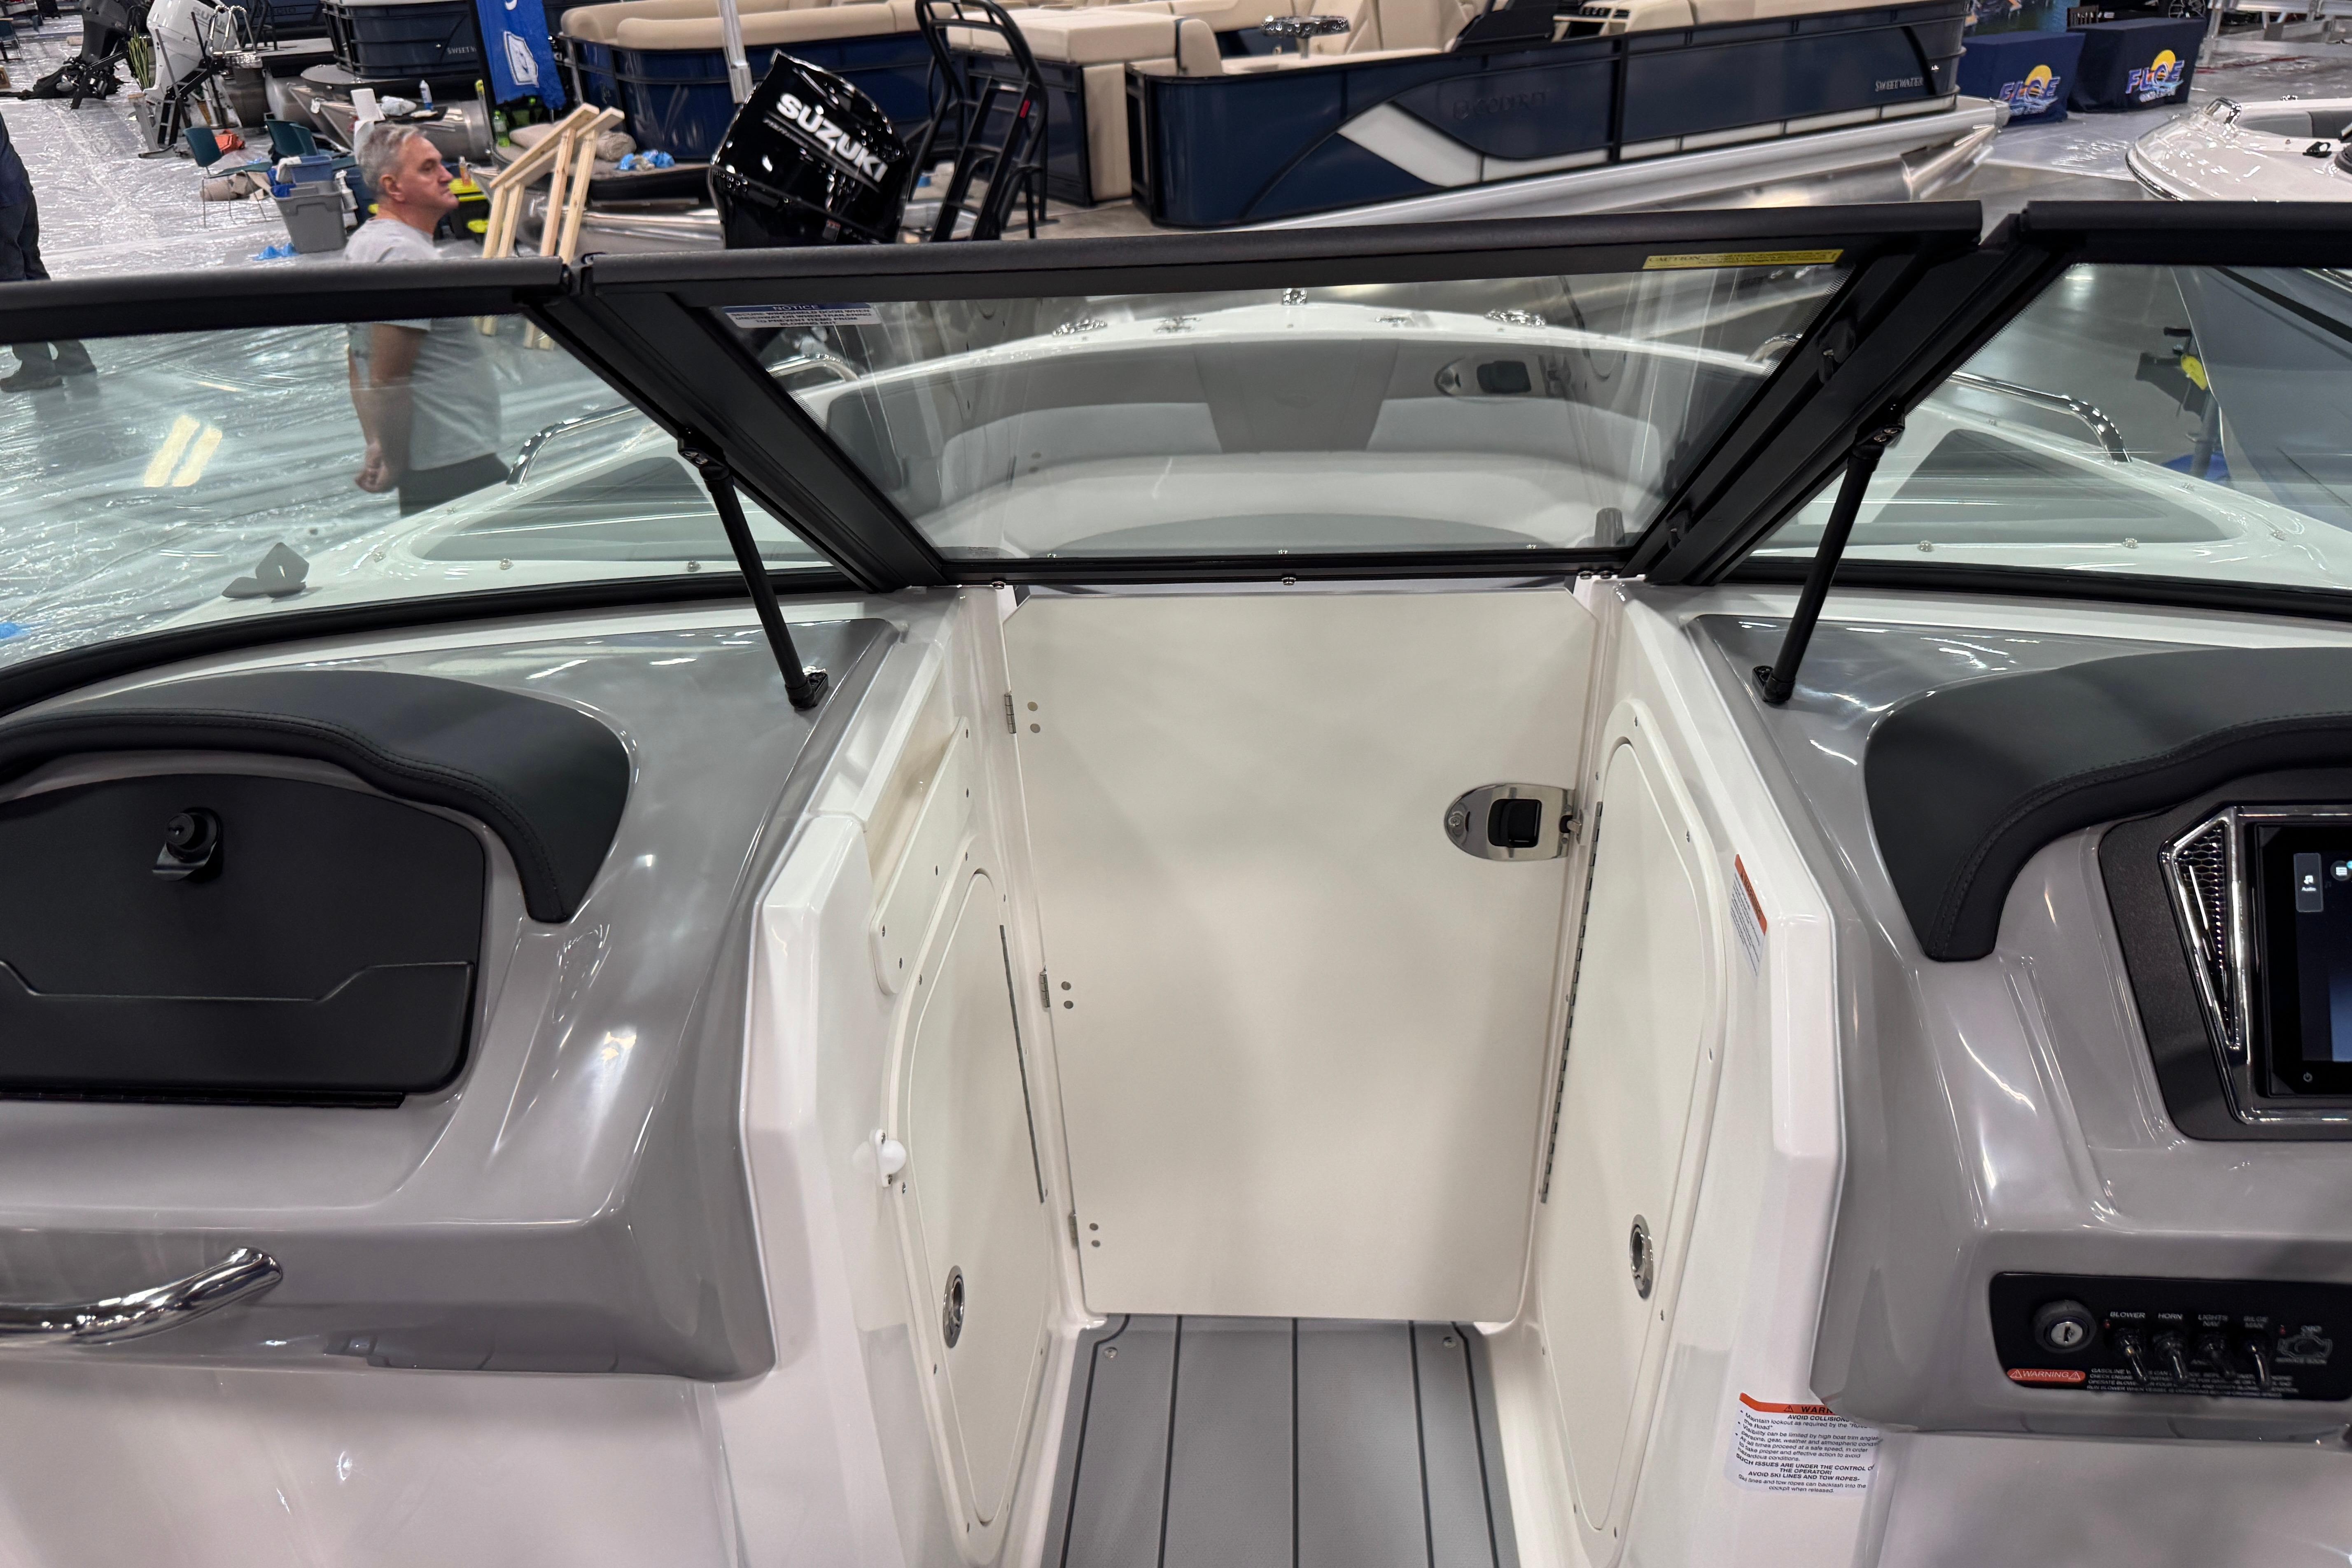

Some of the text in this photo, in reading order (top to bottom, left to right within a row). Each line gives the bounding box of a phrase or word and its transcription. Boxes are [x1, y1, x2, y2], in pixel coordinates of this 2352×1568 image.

[2125, 60, 2185, 94] FLOE
[1999, 76, 2061, 105] FLOE
[775, 92, 889, 183] SUZUKI
[1744, 1418, 1752, 1427] the
[1745, 1412, 1769, 1423] Maintain
[1743, 1424, 1766, 1436] Visibility
[1736, 1453, 1753, 1465] SUCH
[1738, 1447, 1767, 1459] hazardous
